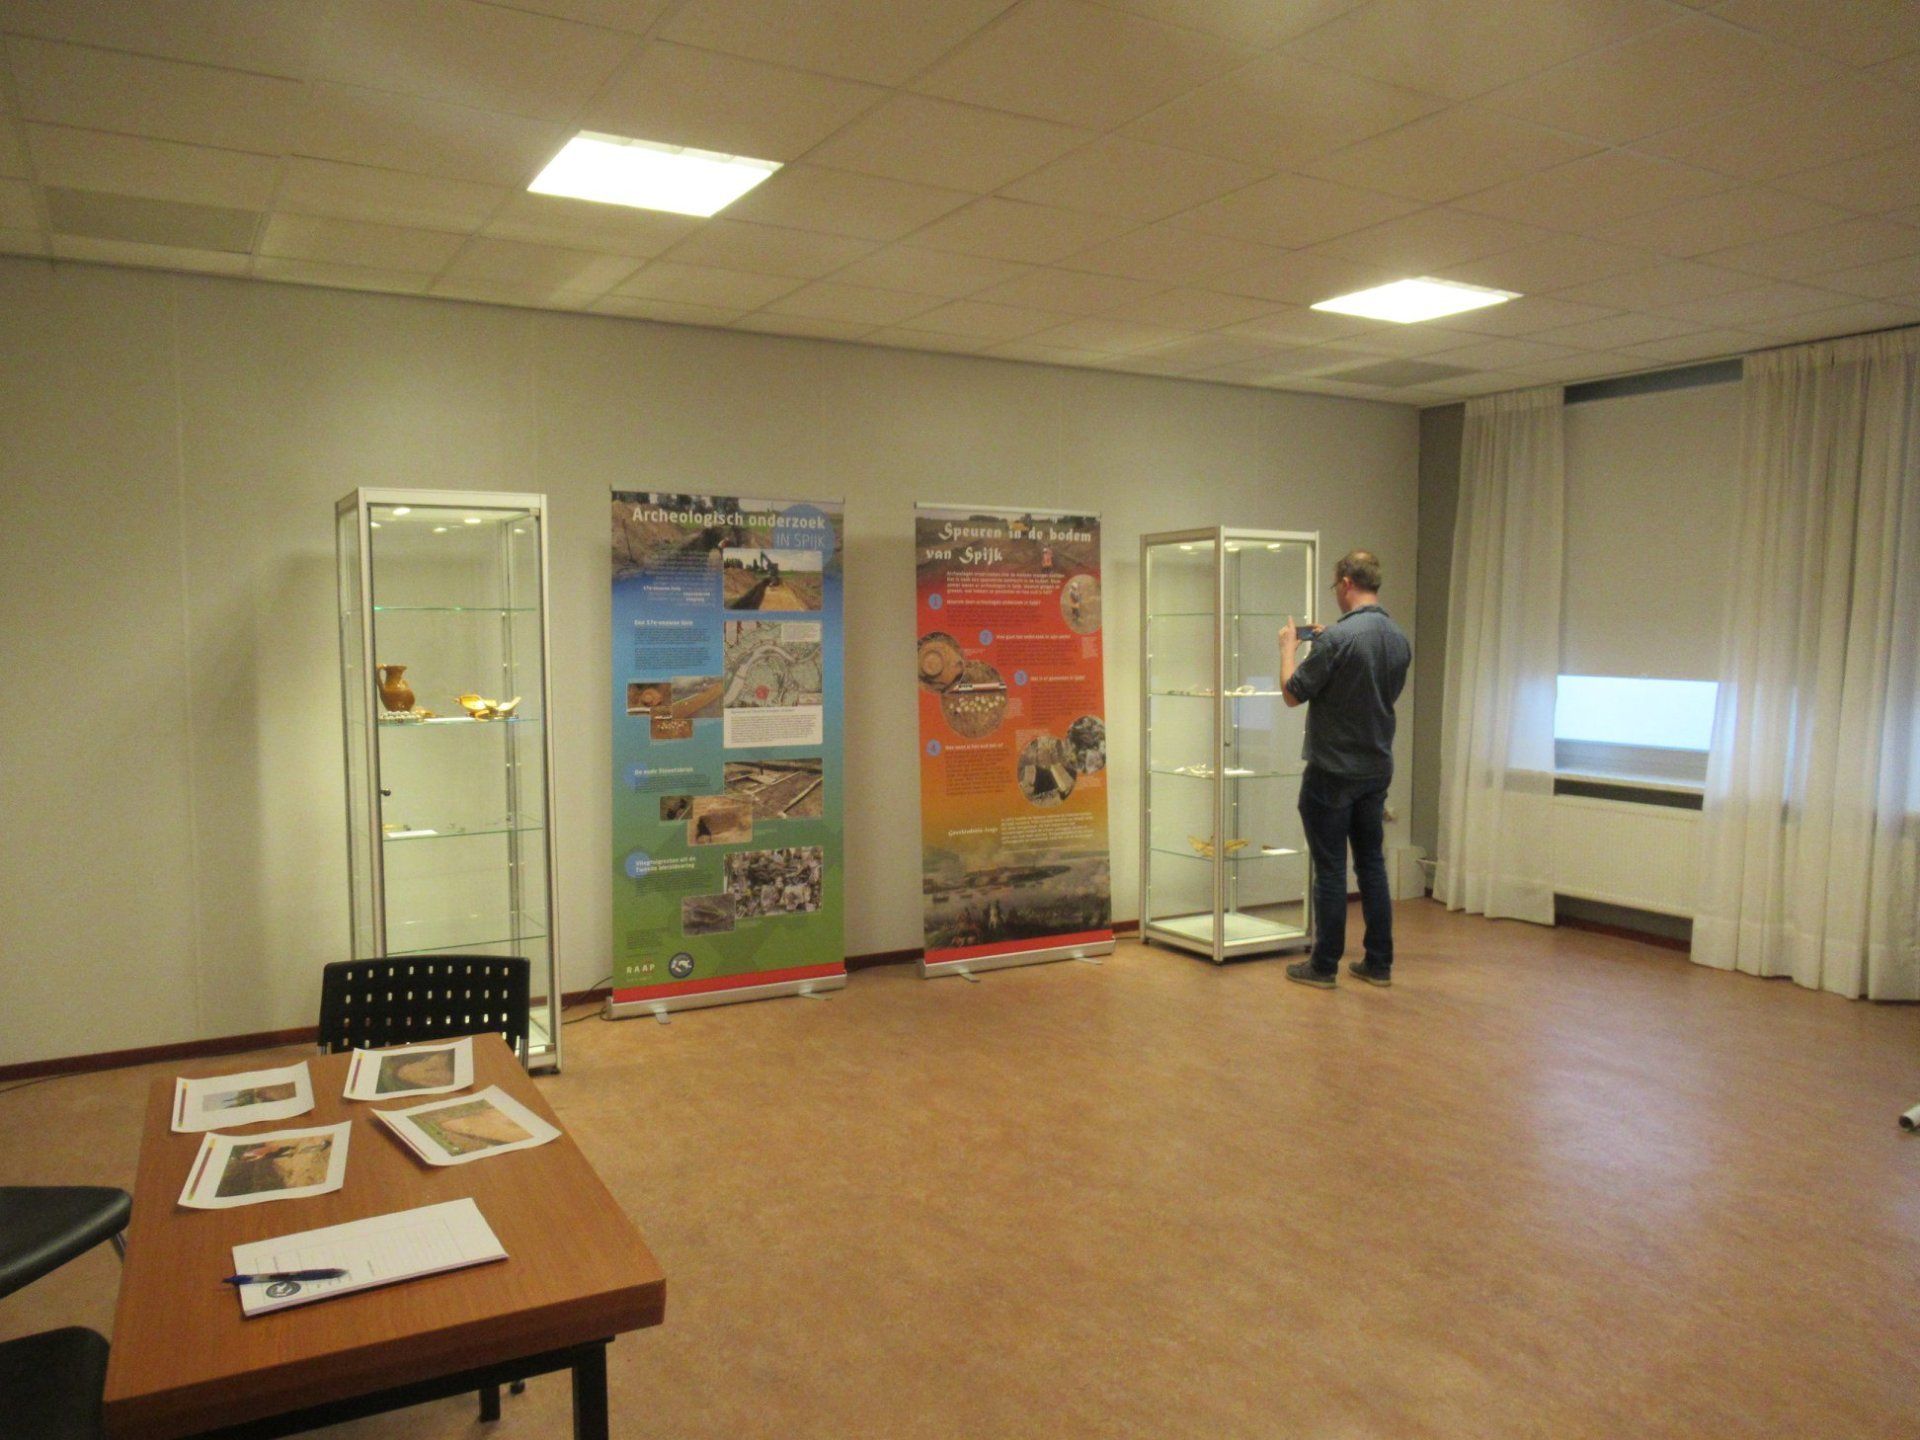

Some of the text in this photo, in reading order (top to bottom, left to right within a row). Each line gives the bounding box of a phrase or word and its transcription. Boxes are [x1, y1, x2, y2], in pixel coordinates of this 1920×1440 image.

[632, 507, 825, 530] Archeologisch onderzoek
[776, 534, 825, 549] IN SPIJK
[938, 522, 1092, 543] Speuren in de bodem
[926, 546, 1003, 566] van Spijk
[626, 963, 655, 974] RAAP
